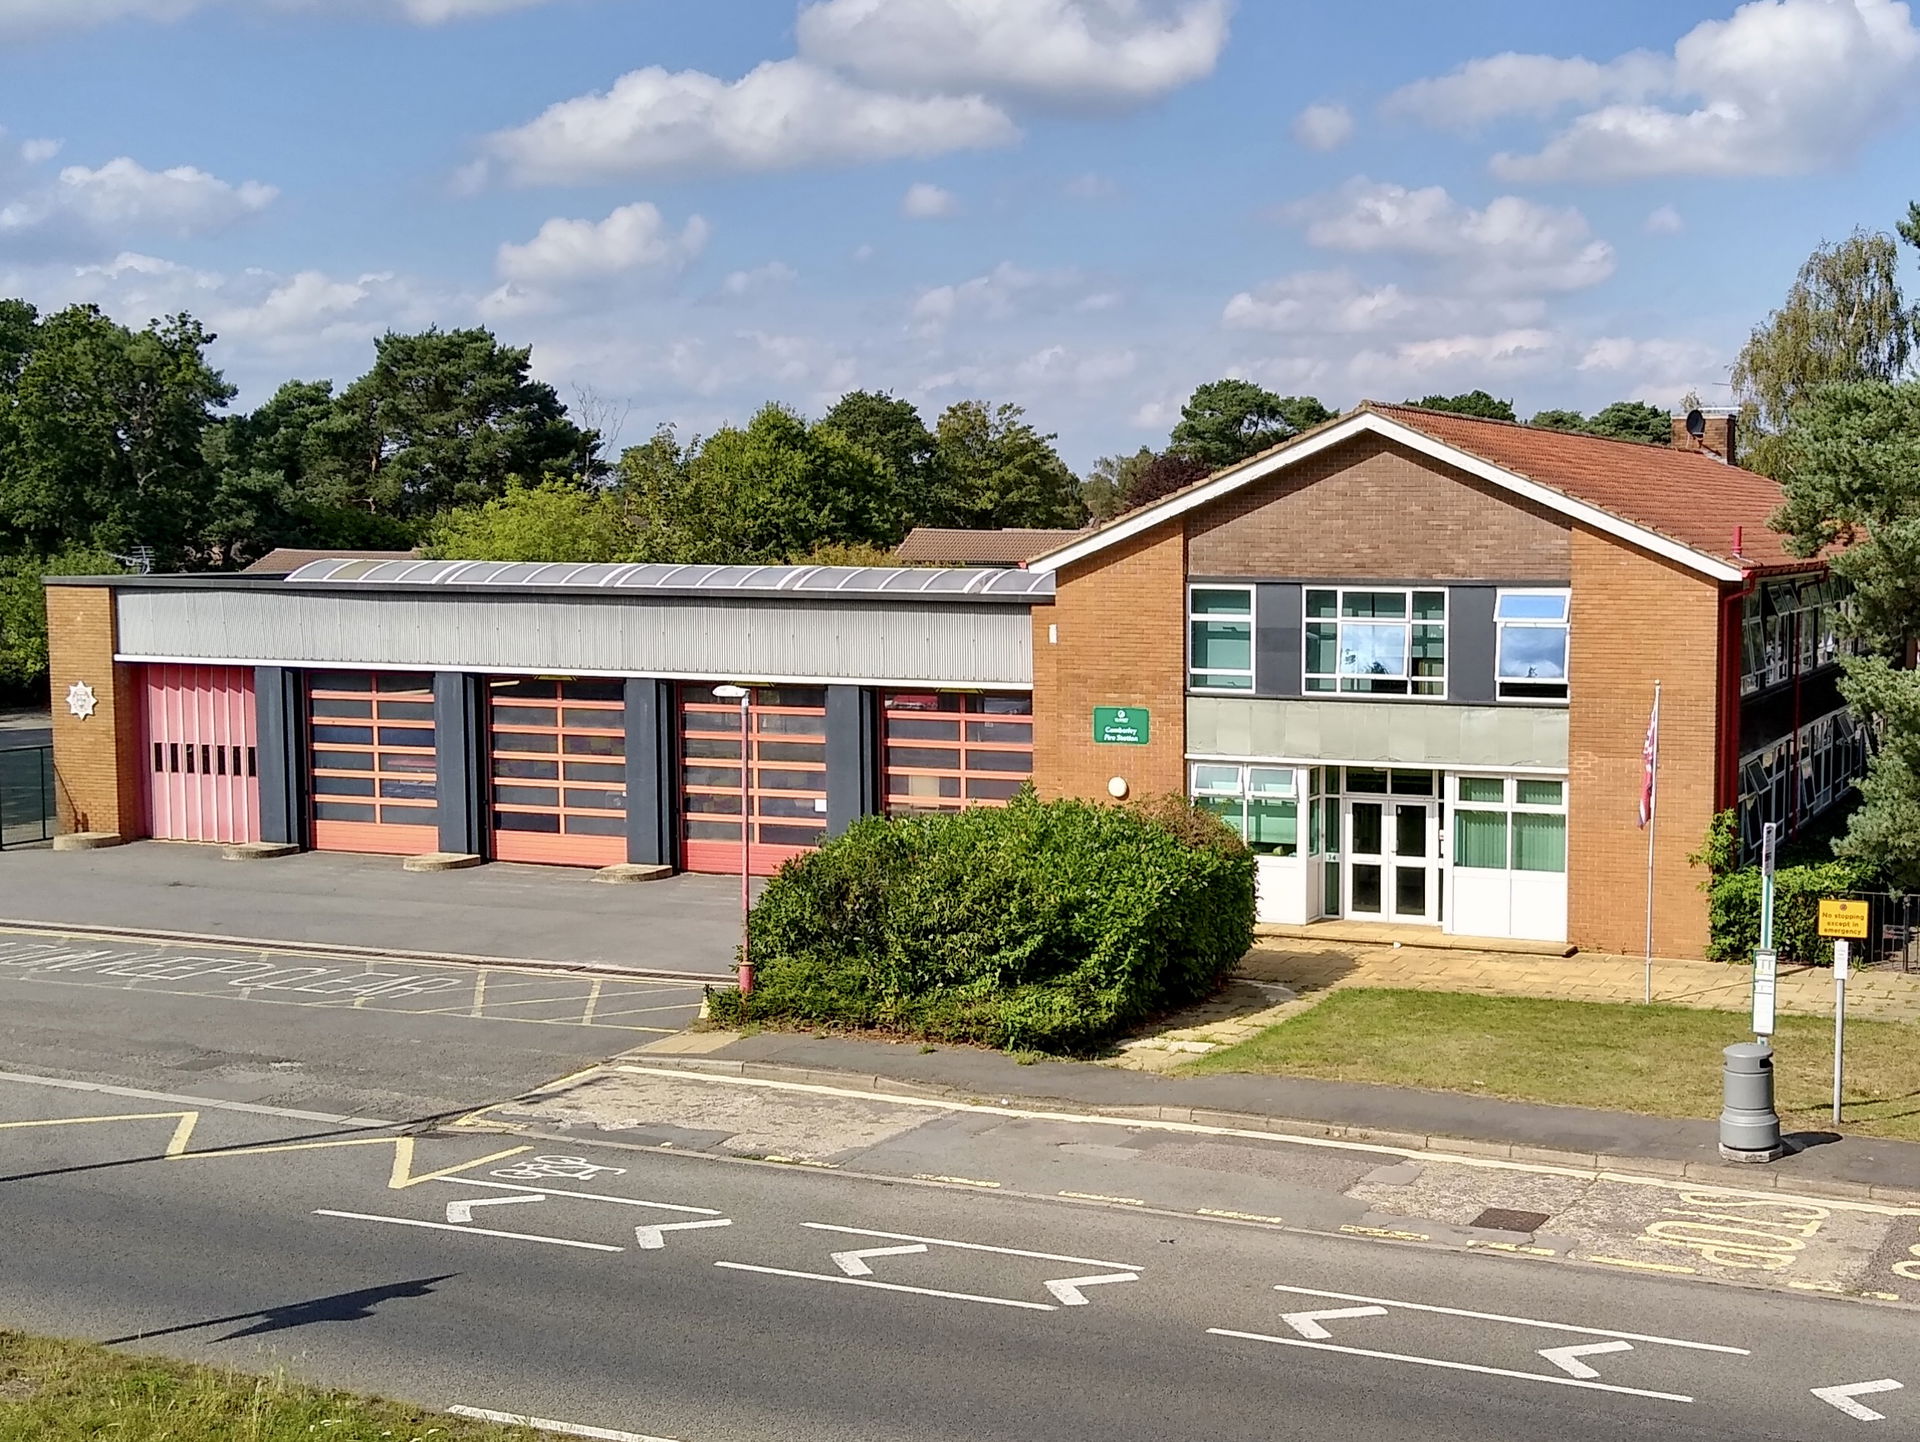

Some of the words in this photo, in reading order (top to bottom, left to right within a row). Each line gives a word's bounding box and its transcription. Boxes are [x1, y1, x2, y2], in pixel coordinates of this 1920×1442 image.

[1104, 733, 1116, 741] Fire
[1116, 734, 1139, 742] Station
[1834, 913, 1865, 921] stopping
[1823, 928, 1862, 936] emergency
[70, 954, 276, 981] KEEP
[228, 967, 463, 999] CLEAR
[1636, 1191, 1831, 1270] STOP
